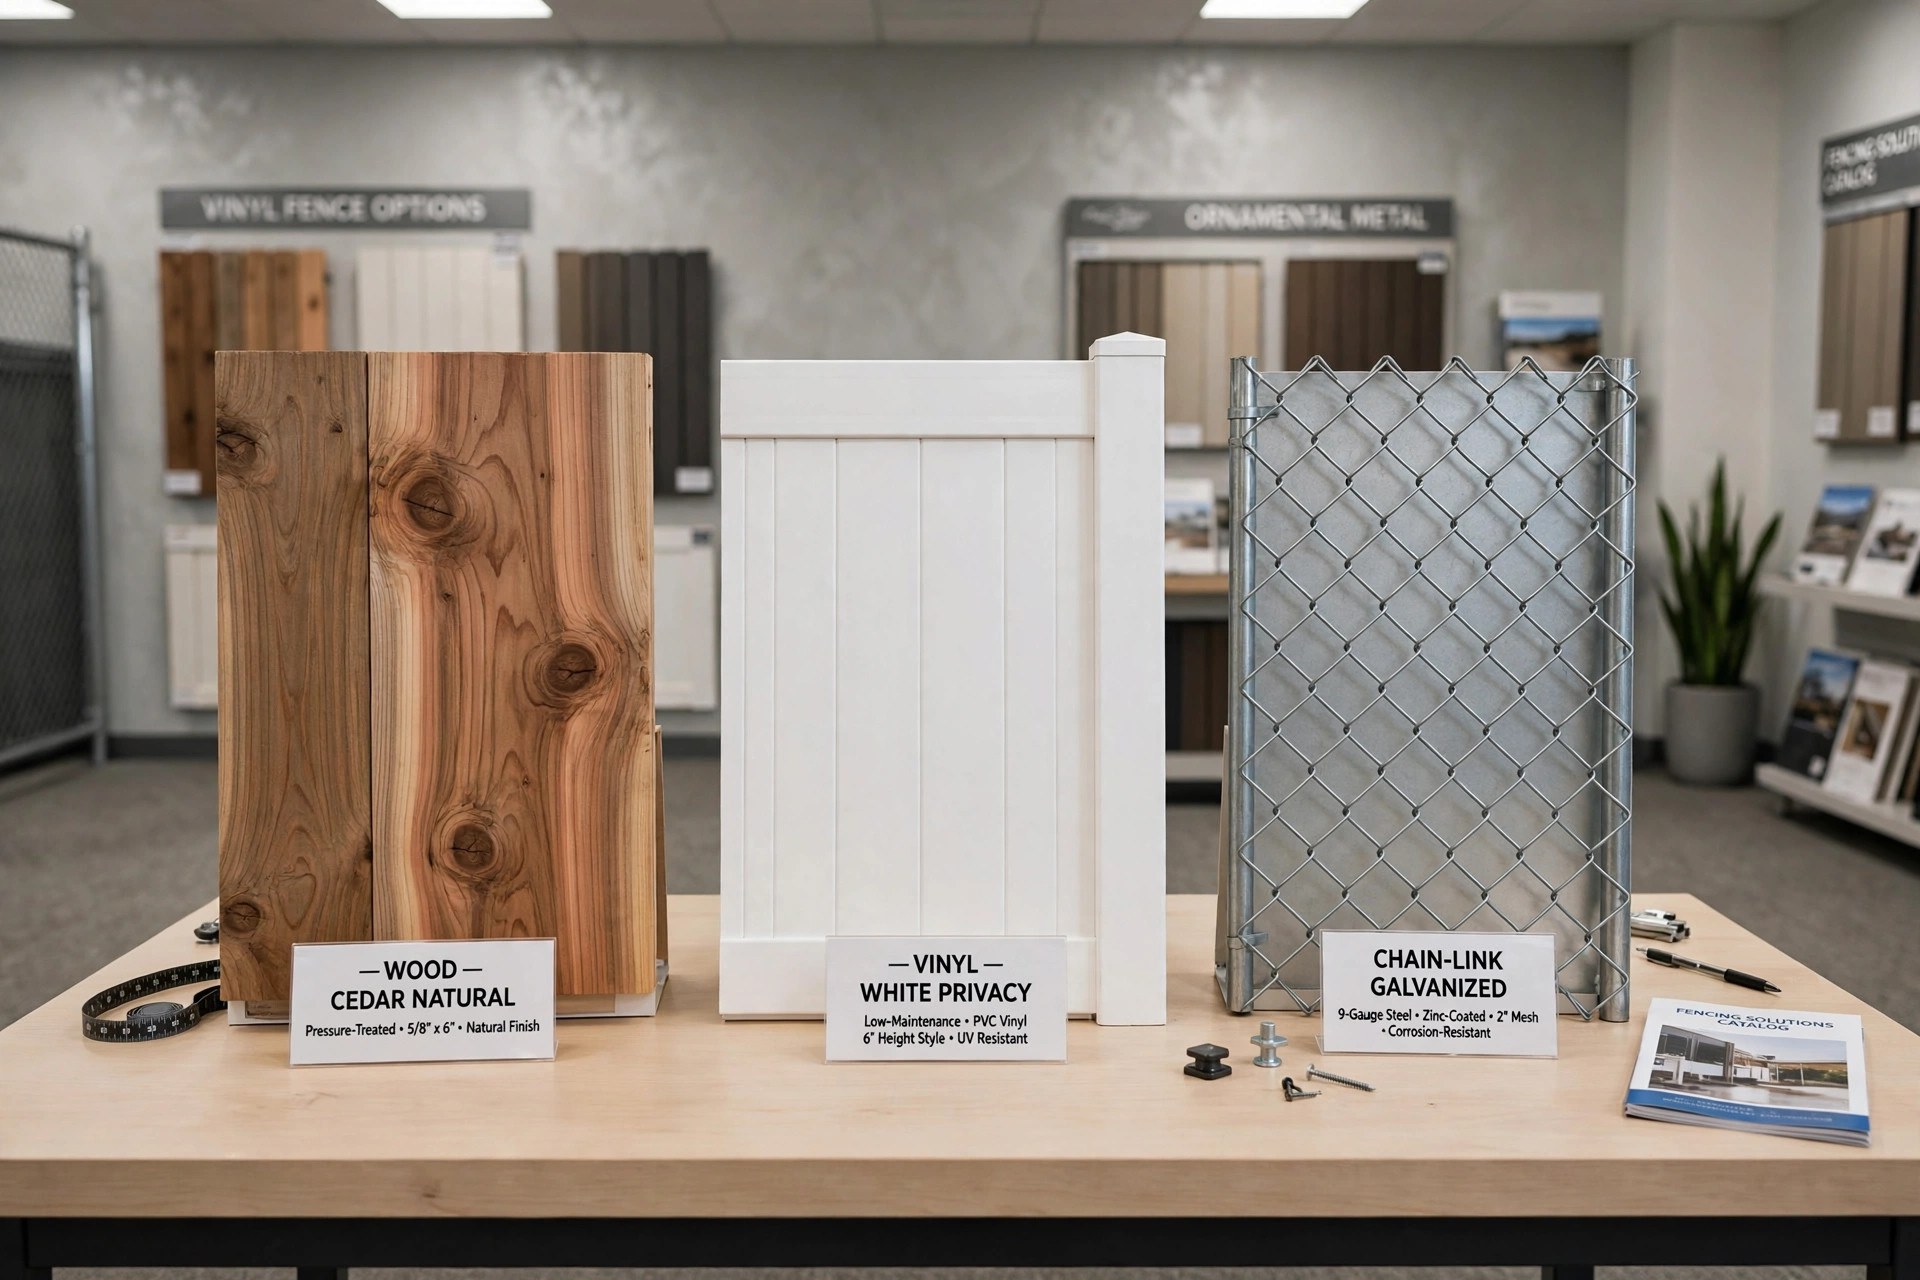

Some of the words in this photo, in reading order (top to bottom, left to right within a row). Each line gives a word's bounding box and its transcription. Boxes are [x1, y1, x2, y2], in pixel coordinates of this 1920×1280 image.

[201, 193, 281, 223] VINYL
[283, 194, 368, 223] FENCE
[369, 193, 487, 223] OPTIONS
[1184, 202, 1347, 231] ORNAMENTAL
[1350, 203, 1430, 231] METAL
[1373, 948, 1504, 971] CHAIN-LINK
[859, 982, 932, 1003] WHITE
[938, 982, 1033, 1003] PRIVACY
[1370, 976, 1507, 999] GALVANIZED
[330, 989, 406, 1011] CEDAR
[412, 986, 516, 1009] NATURAL
[864, 1014, 962, 1028] Low-Maintenance
[973, 1014, 997, 1028] PVC
[999, 1013, 1027, 1031] Vinyl
[1337, 1007, 1384, 1024] 9-Gauge
[1385, 1008, 1412, 1022] Steel
[1422, 1008, 1486, 1023] Zinc-Coated
[1496, 1010, 1509, 1023] 2"
[1511, 1010, 1539, 1024] Mesh
[1676, 1007, 1741, 1021] FENCING
[1746, 1015, 1834, 1029] SOLUTIONS
[1717, 1018, 1789, 1032] CATALOG
[305, 1021, 396, 1037] Pressure-Treated
[407, 1020, 432, 1037] 5/8"
[433, 1024, 441, 1035] x
[442, 1021, 456, 1034] 6"
[466, 1019, 506, 1034] Natural
[509, 1018, 540, 1033] Finish
[1387, 1024, 1492, 1039] Corrosion-Resistant
[862, 1031, 875, 1045] 6"
[878, 1031, 916, 1048] Height
[917, 1031, 946, 1048] Style
[957, 1031, 975, 1045] UV
[977, 1031, 1029, 1045] Resistant
